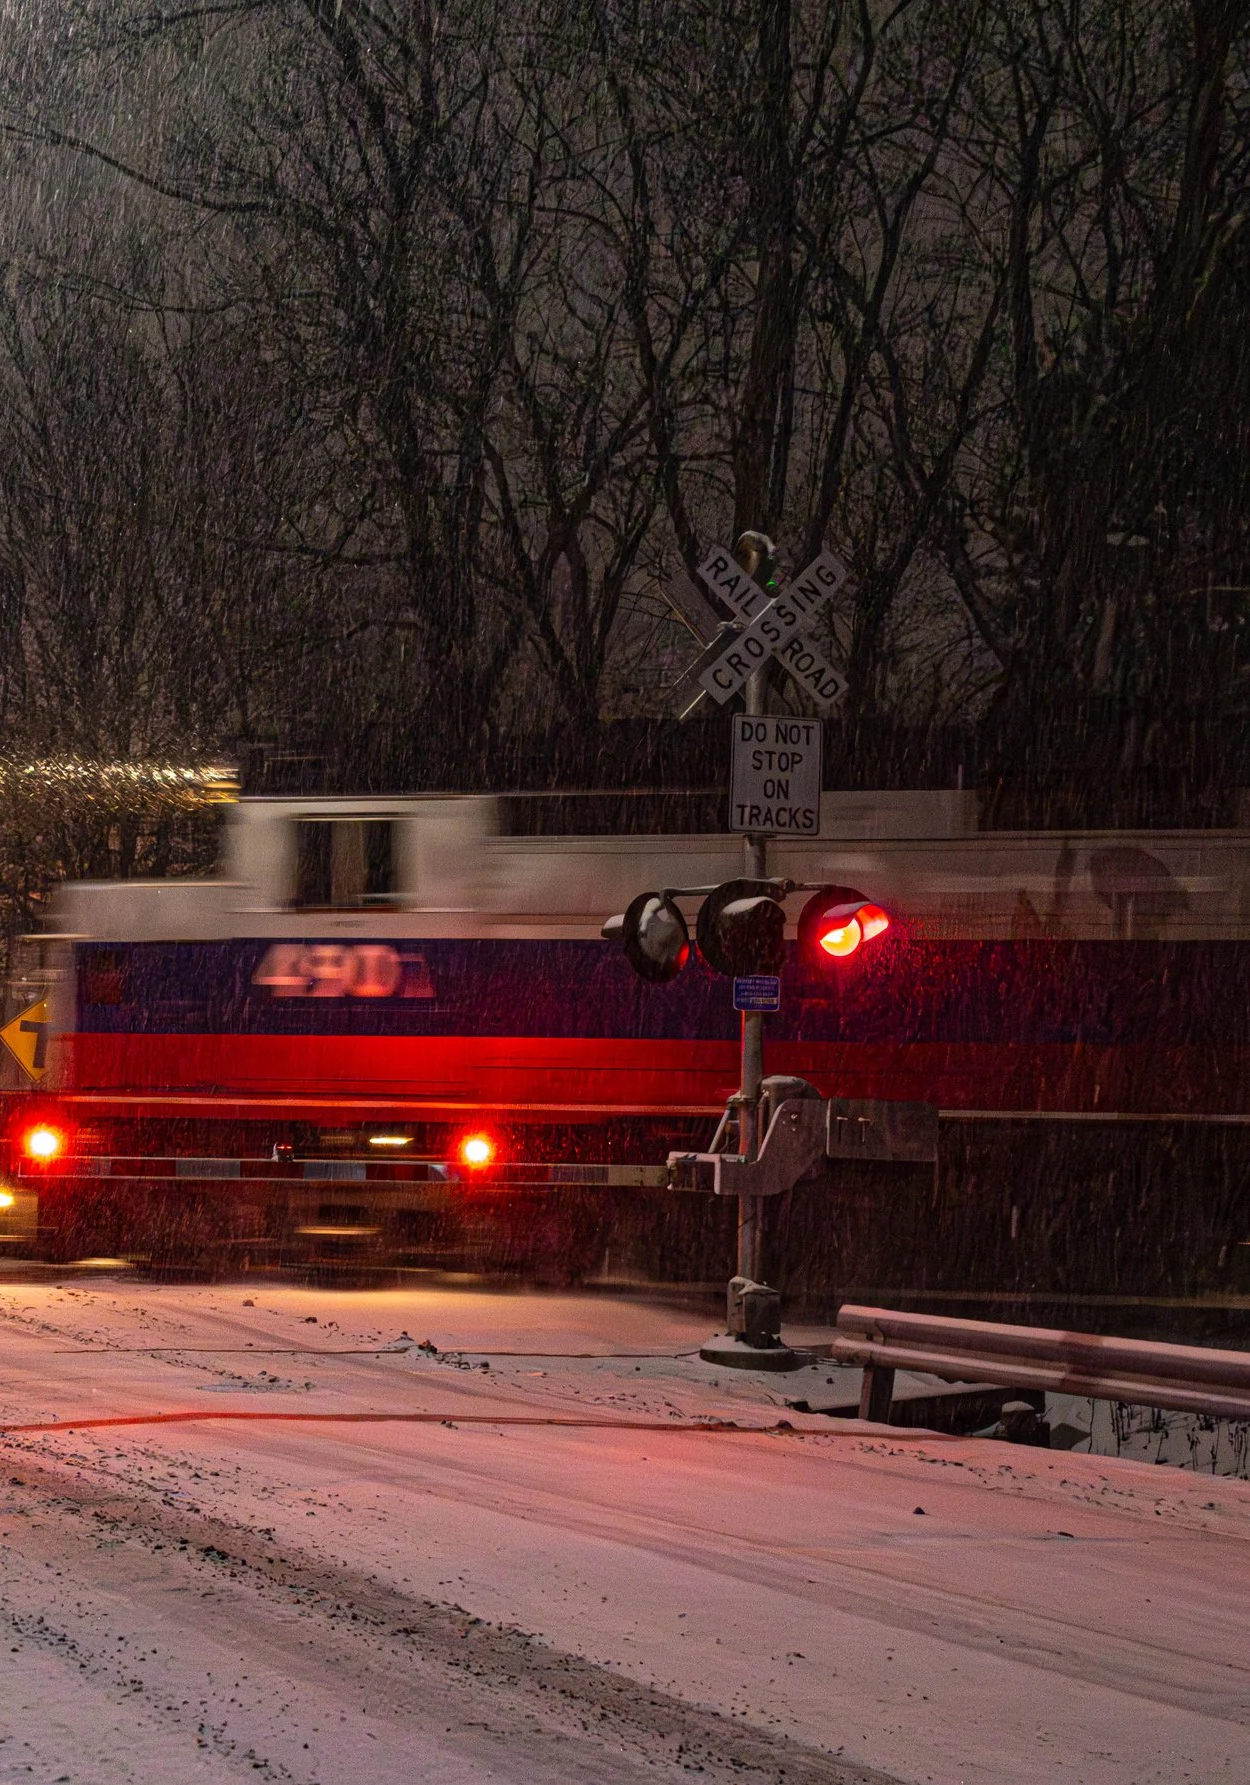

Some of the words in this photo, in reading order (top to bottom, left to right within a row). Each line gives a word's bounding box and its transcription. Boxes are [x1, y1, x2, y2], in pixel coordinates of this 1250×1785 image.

[706, 556, 758, 617] RAIL
[781, 638, 839, 699] ROAD
[712, 565, 837, 690] CROSSING
[741, 721, 767, 742] DO
[775, 723, 814, 745] NOT
[752, 750, 803, 772] STOP
[764, 779, 789, 800] ON
[736, 804, 814, 829] TRACKS
